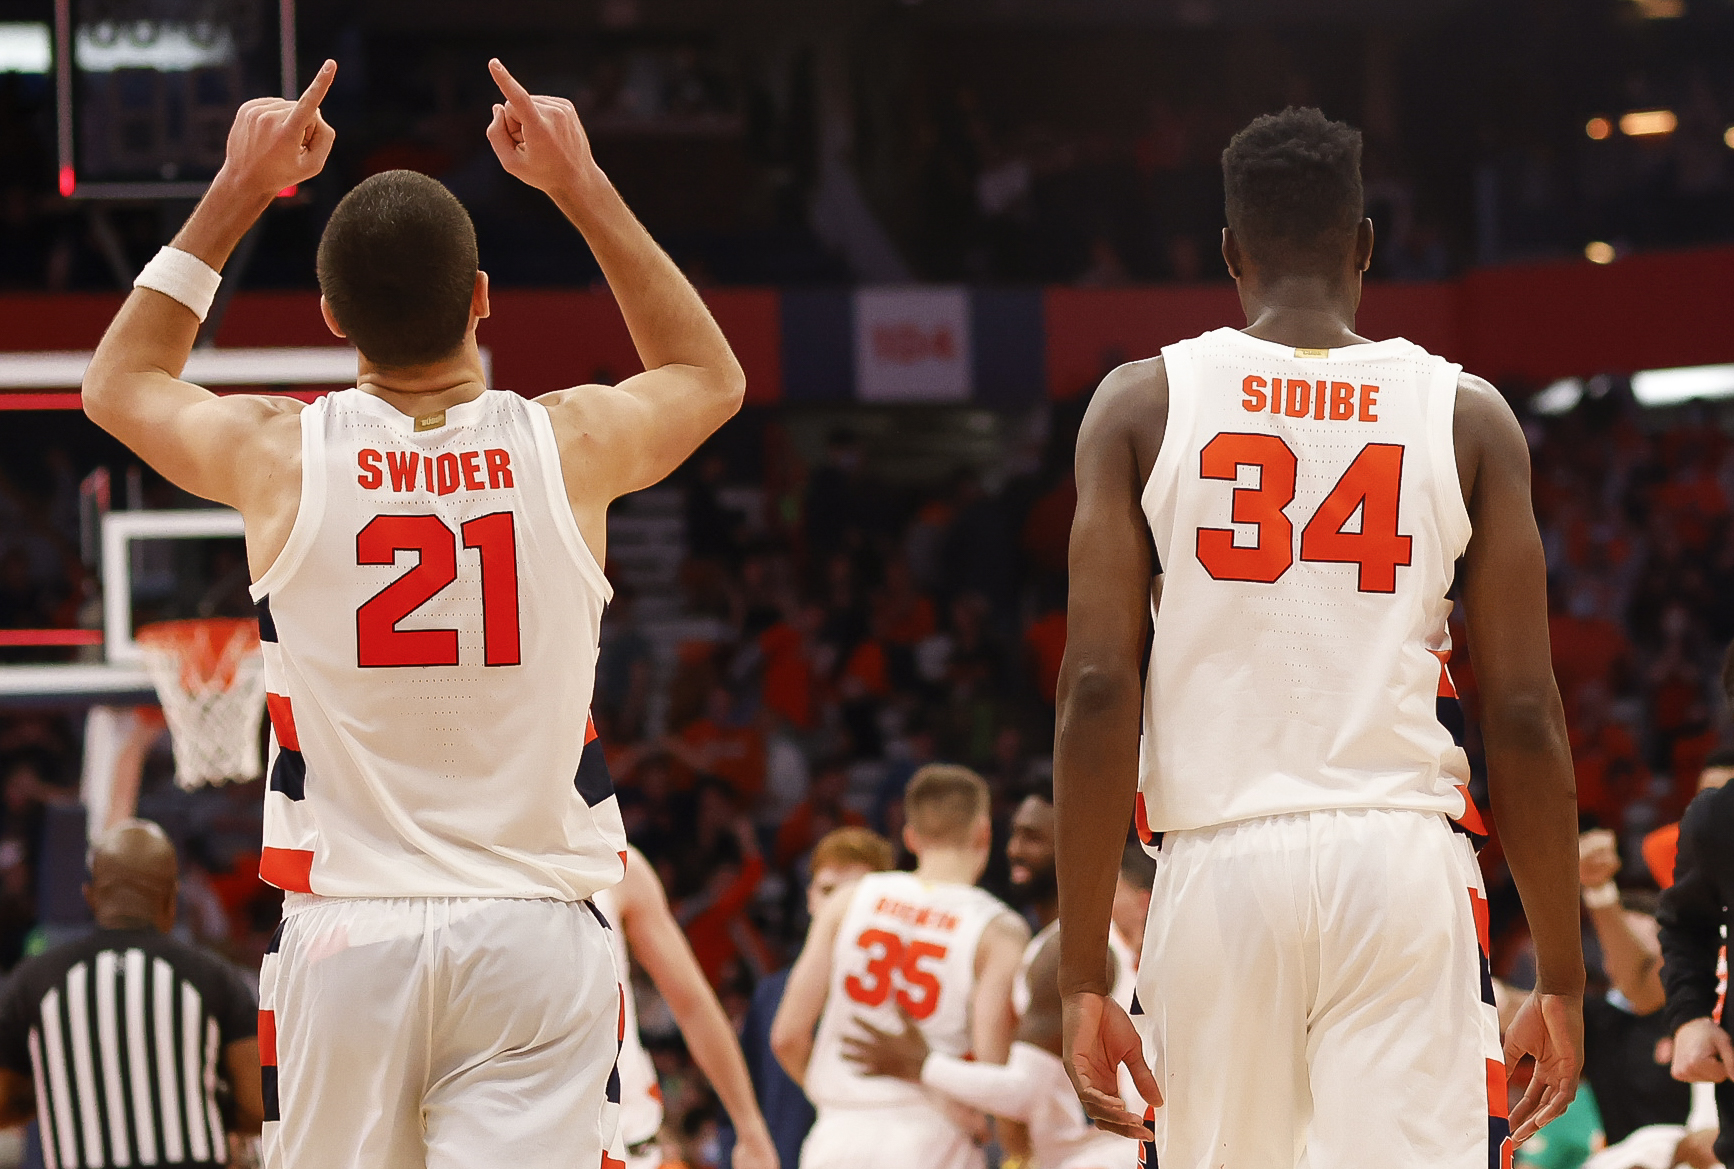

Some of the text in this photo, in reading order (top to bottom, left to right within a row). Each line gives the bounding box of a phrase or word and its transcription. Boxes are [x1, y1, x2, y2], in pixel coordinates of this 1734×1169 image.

[1242, 374, 1380, 422] SIDIBE
[357, 448, 515, 497] SWIDER
[1195, 431, 1413, 594] 34
[356, 511, 522, 668] 21
[844, 928, 948, 1021] 35
